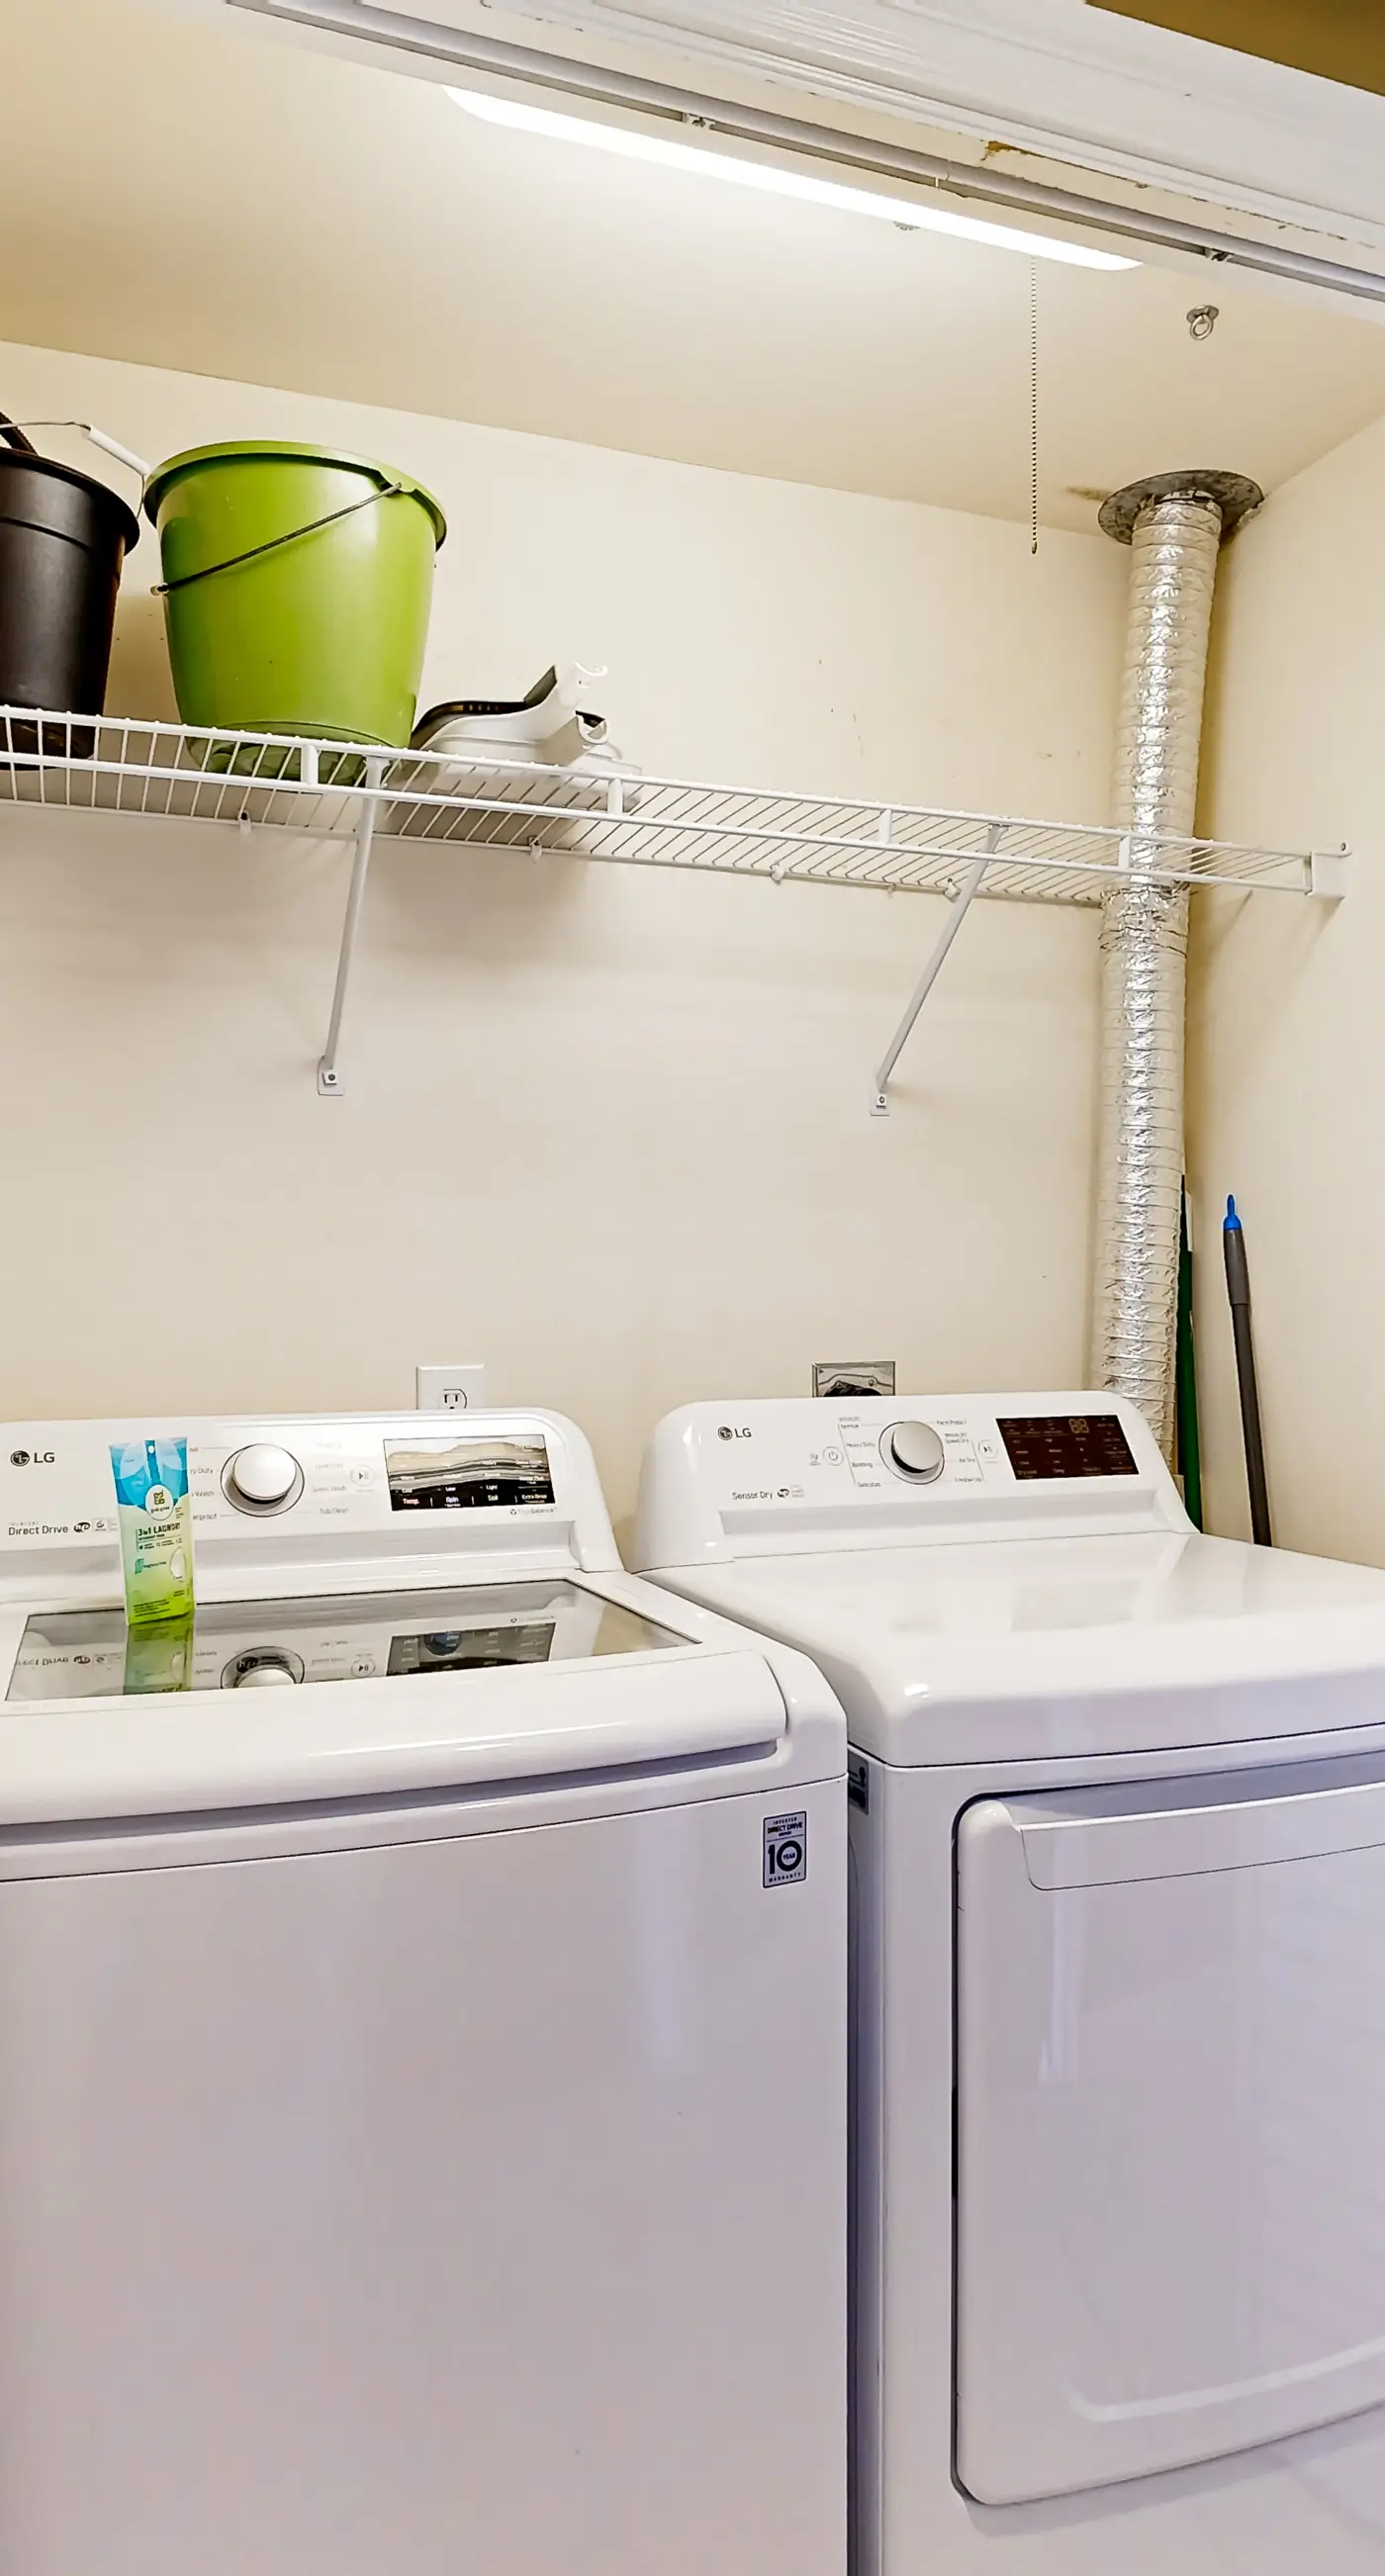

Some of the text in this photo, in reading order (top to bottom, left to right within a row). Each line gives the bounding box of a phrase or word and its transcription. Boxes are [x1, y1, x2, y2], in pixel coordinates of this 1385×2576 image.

[735, 1427, 752, 1438] LG
[34, 1451, 55, 1463] LG
[760, 1490, 774, 1500] Dry
[8, 1525, 69, 1536] Direct Drive
[768, 1825, 786, 1834] DIRECT
[786, 1821, 803, 1830] DRIVE
[768, 1840, 802, 1875] 10
